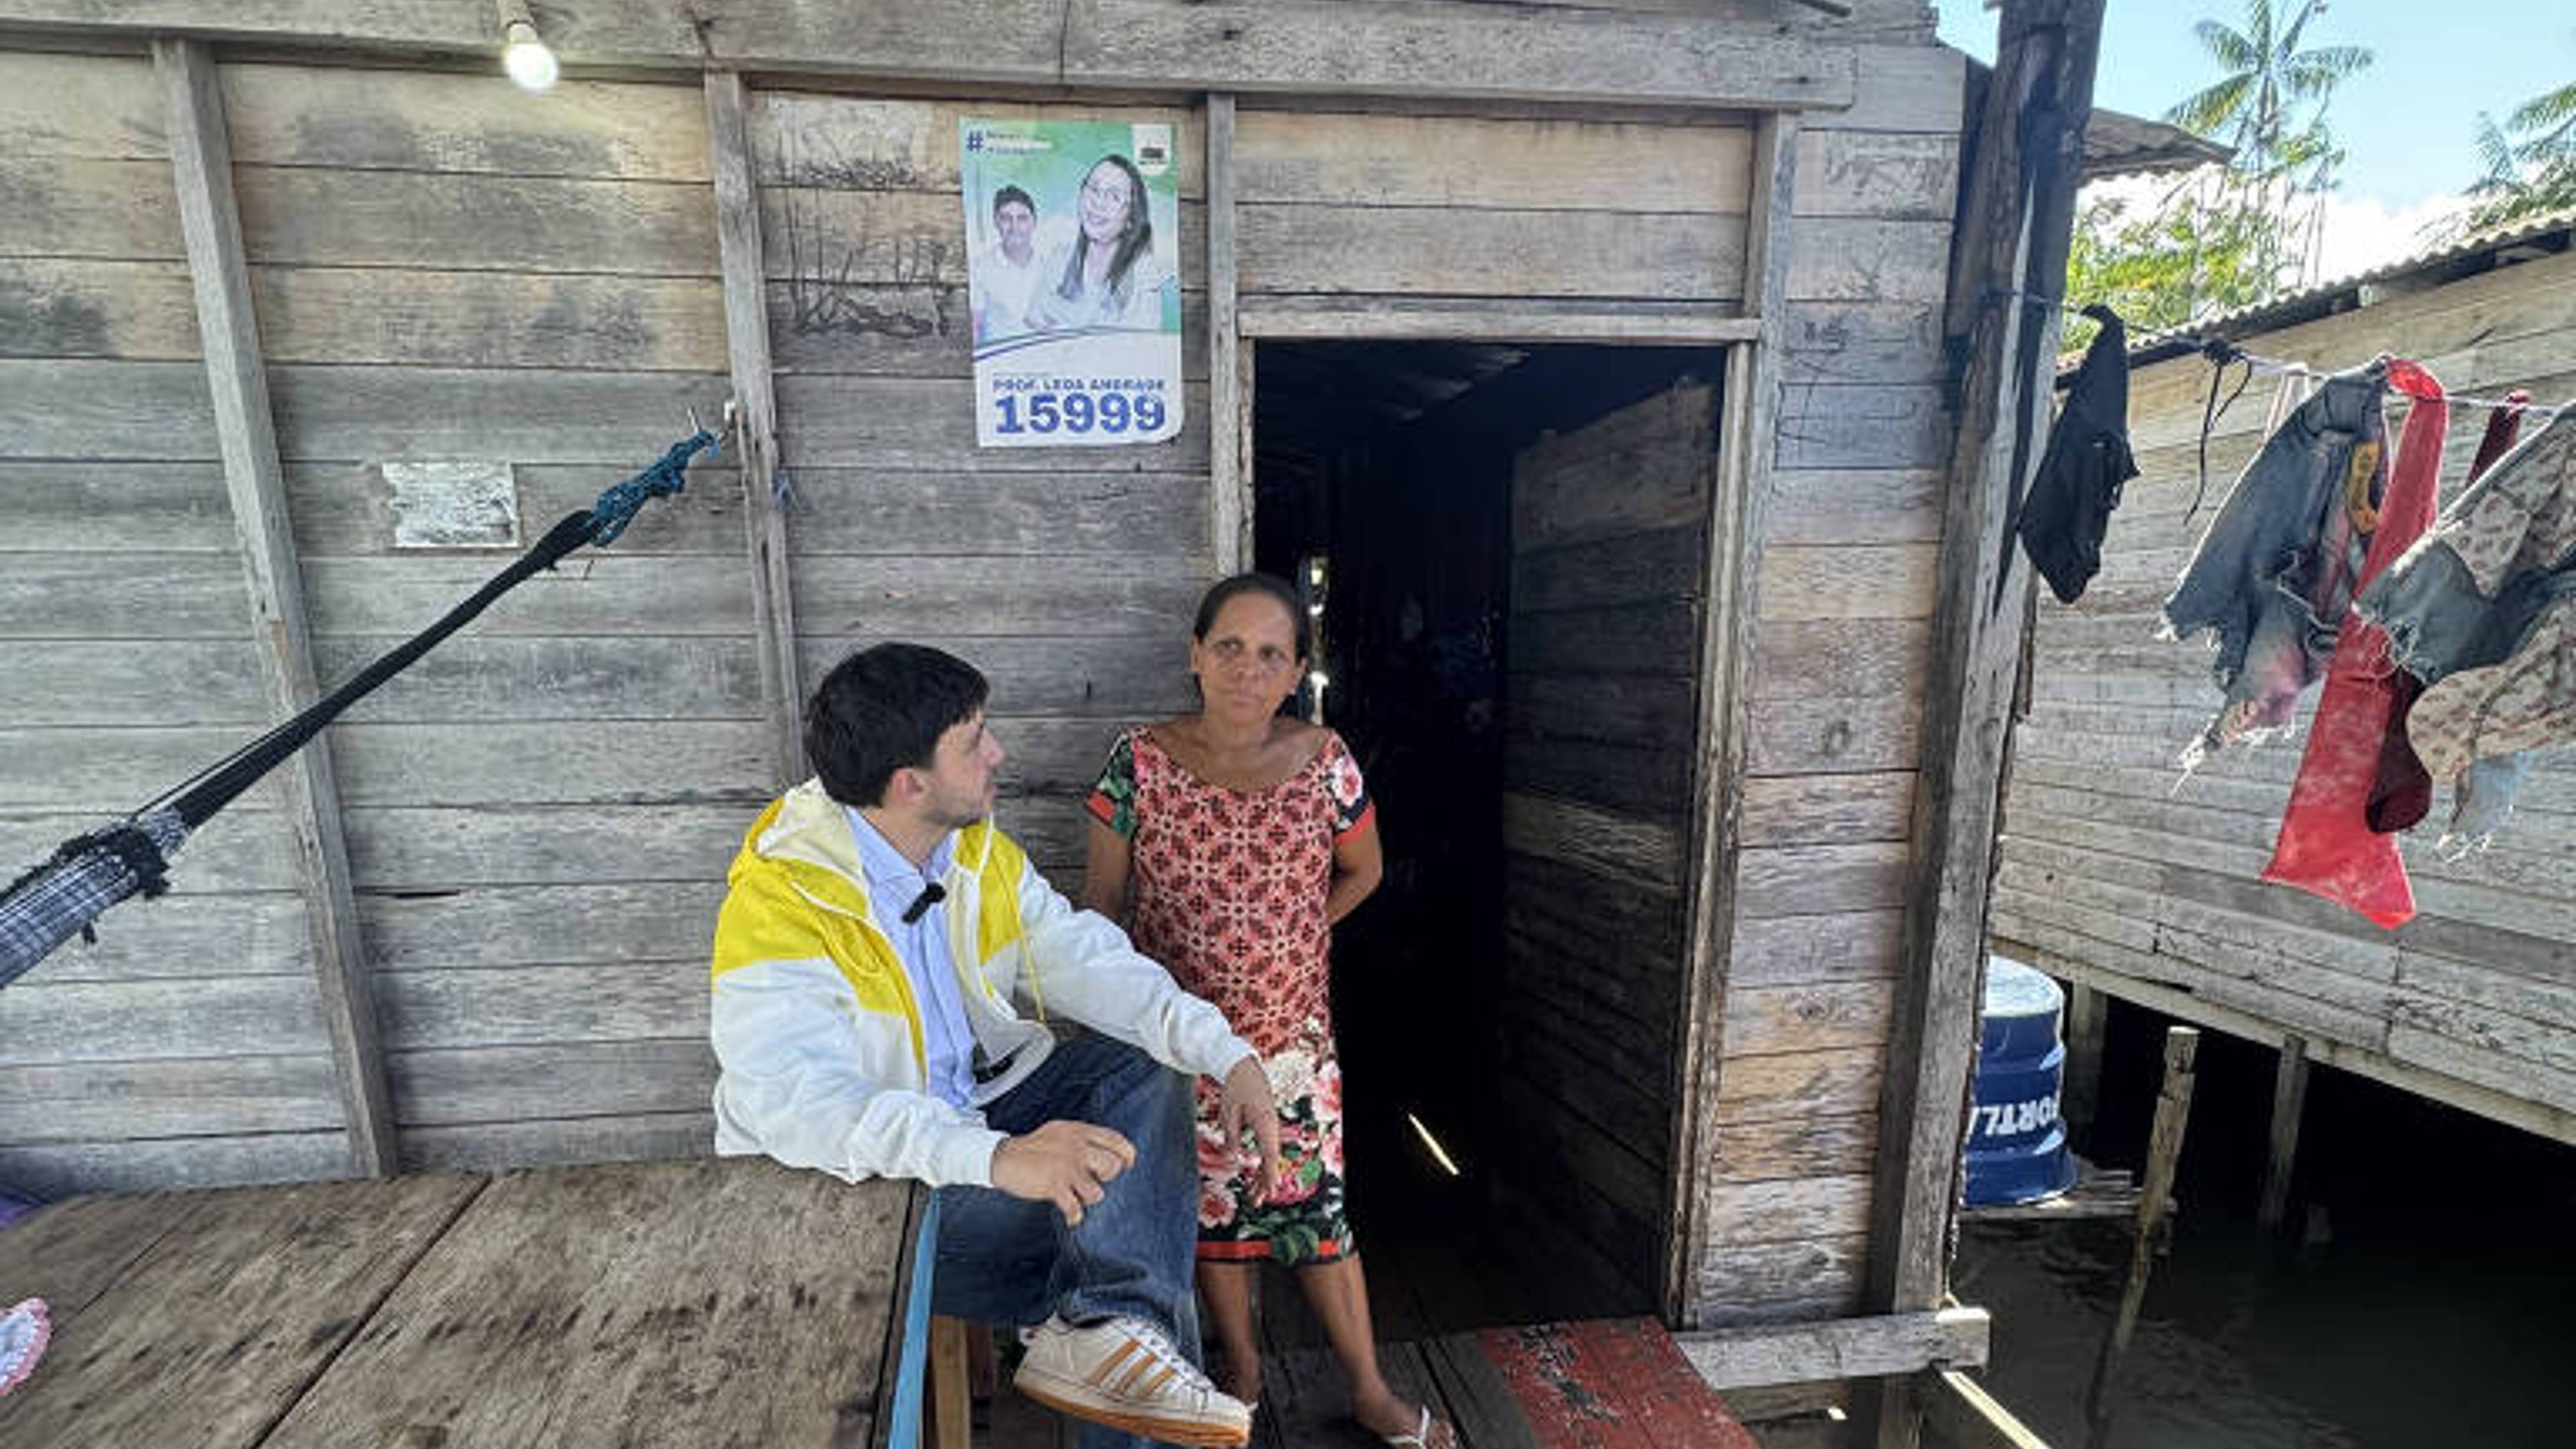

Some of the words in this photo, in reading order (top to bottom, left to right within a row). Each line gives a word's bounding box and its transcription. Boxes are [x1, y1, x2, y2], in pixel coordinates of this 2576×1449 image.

[1043, 378, 1084, 390] LEDA
[1090, 378, 1165, 390] ANDRADE
[995, 392, 1165, 434] 15999
